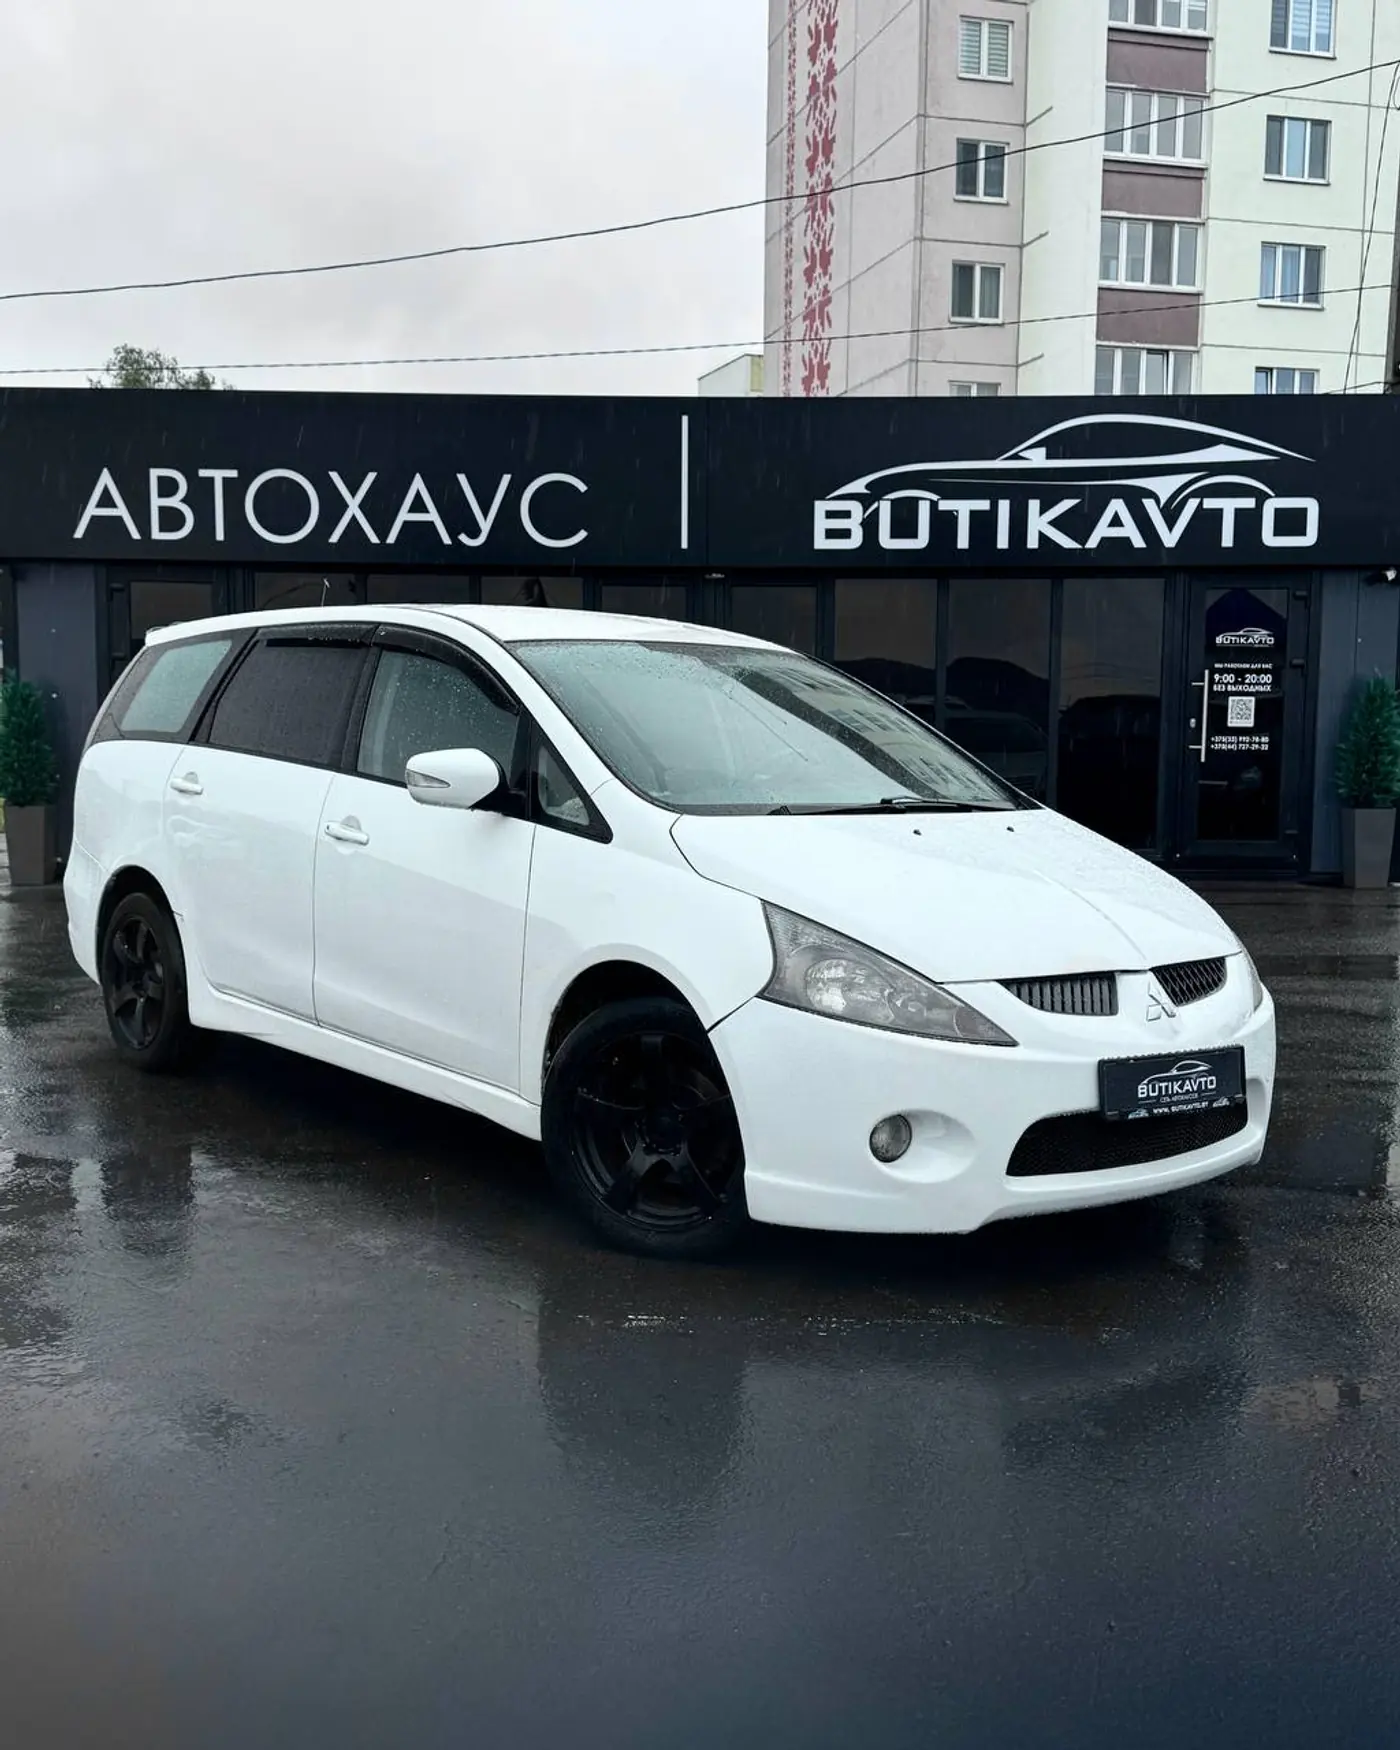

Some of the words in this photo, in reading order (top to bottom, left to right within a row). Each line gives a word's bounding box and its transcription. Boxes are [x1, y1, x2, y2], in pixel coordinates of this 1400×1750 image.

[73, 467, 588, 549] АВТОХАУС
[813, 497, 1320, 550] BUTIKAVTO
[1215, 636, 1275, 645] BUTIKAVTO
[1214, 673, 1235, 683] 9:00
[1244, 673, 1272, 683] 20:00
[1213, 684, 1226, 692] БЕЗ
[1227, 684, 1272, 692] ВЫХОДНЫХ
[1137, 1076, 1217, 1098] BUTIKAVTO
